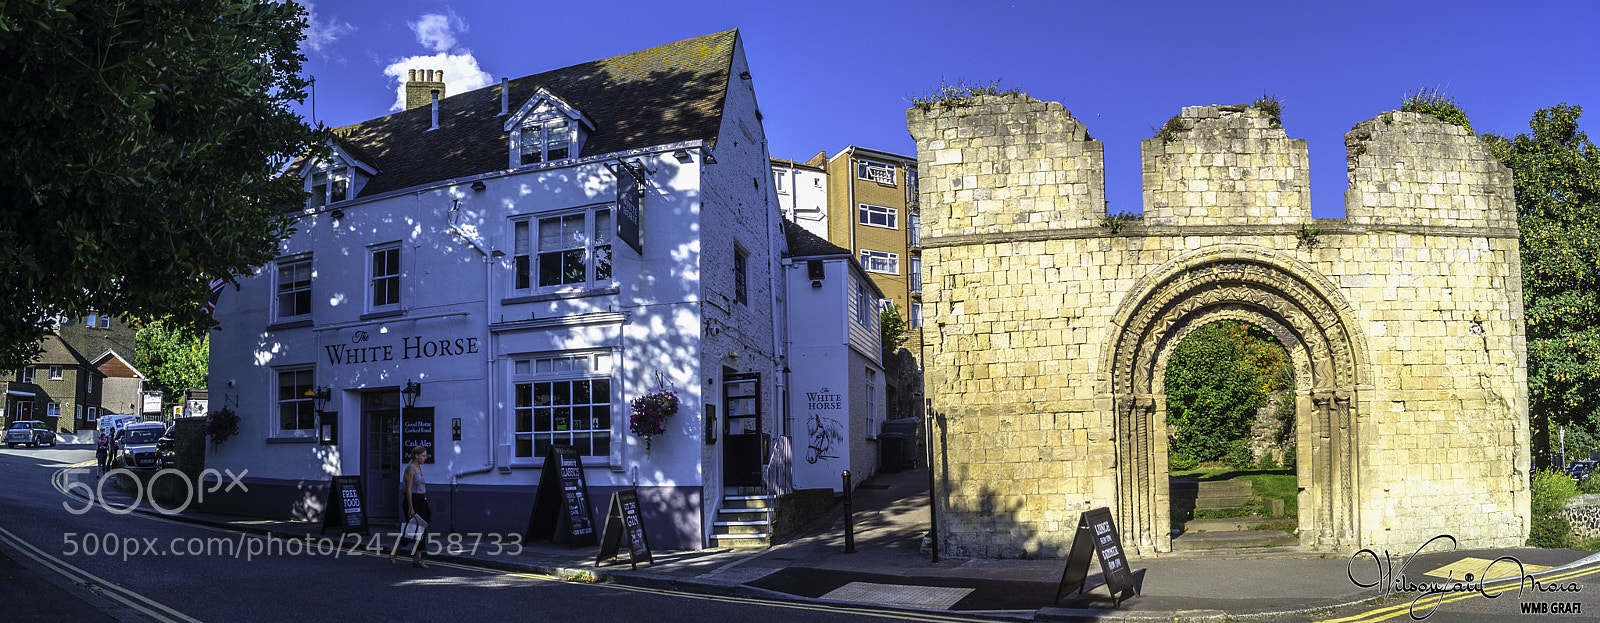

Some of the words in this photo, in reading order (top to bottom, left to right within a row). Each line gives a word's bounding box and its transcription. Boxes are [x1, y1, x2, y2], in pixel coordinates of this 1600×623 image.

[352, 331, 369, 343] The
[806, 392, 842, 402] WHITE
[808, 402, 842, 410] HORSE
[342, 490, 357, 498] FREE
[344, 499, 360, 507] FOOD
